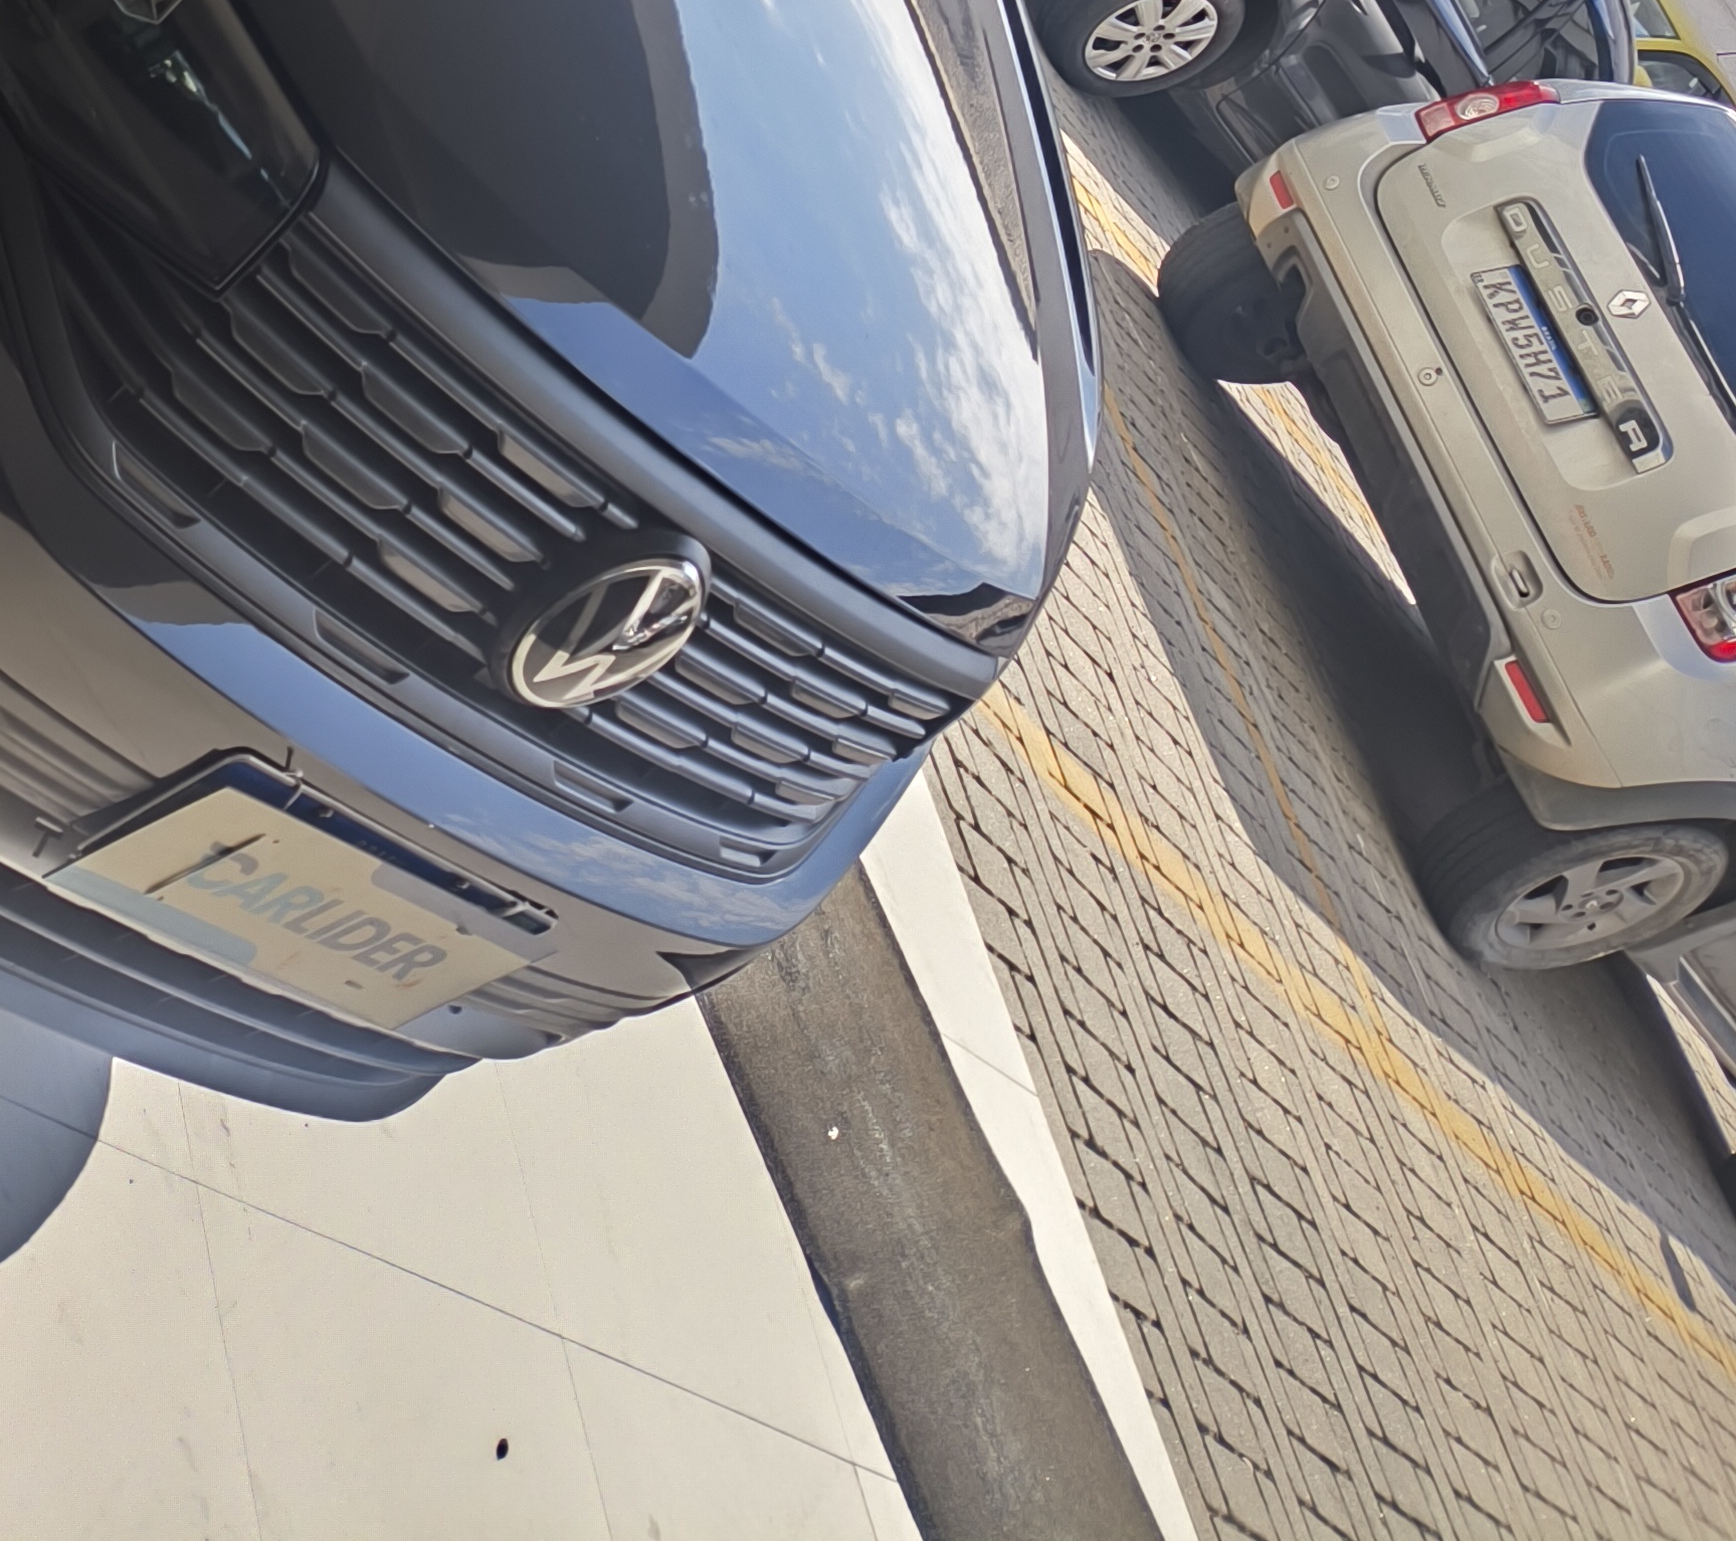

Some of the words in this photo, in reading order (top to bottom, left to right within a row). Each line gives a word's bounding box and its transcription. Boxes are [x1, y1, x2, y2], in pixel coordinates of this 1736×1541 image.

[1482, 280, 1572, 404] KPW5H71
[1502, 205, 1648, 452] DUSTER
[185, 840, 448, 982] CARLIDER
